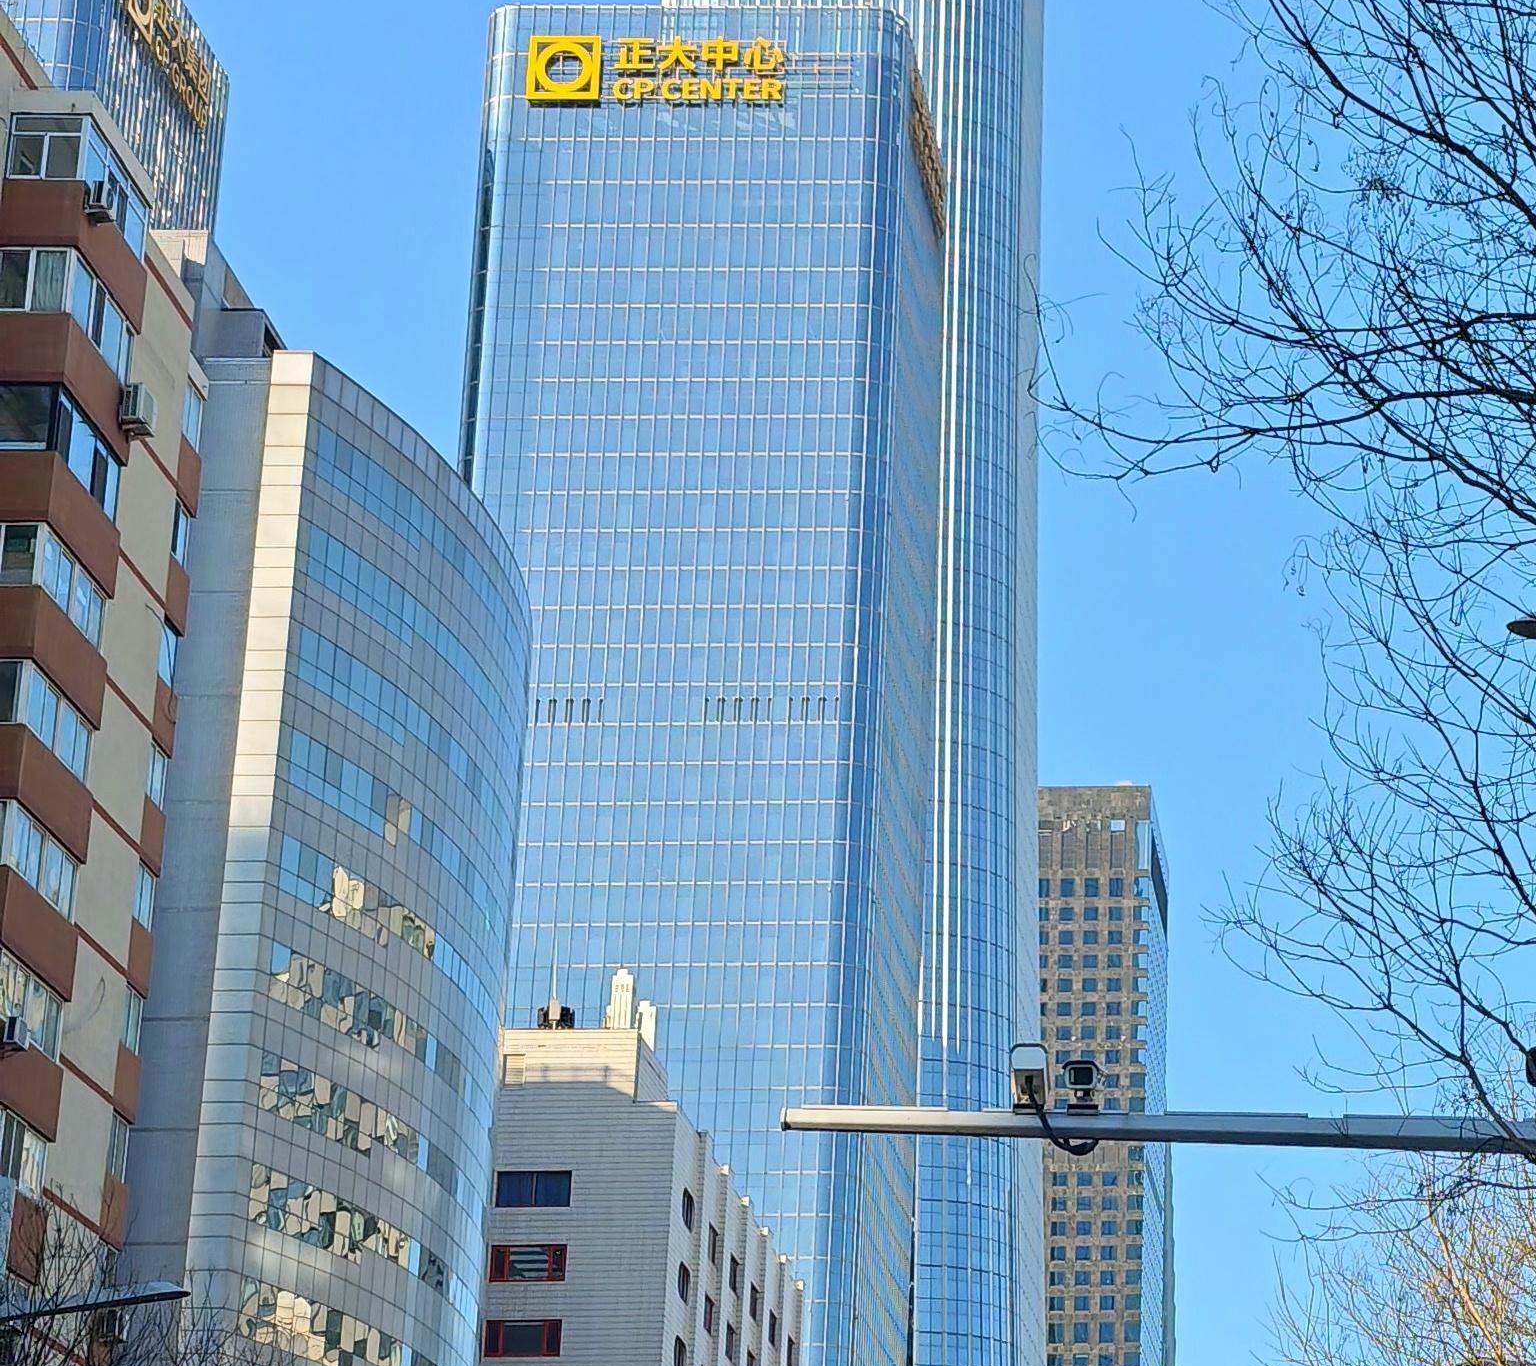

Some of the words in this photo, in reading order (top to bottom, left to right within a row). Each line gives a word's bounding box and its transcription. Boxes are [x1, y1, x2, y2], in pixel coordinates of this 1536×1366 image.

[614, 36, 785, 72] 正大中心
[171, 62, 208, 129] GROUP
[612, 78, 655, 100] CP
[661, 78, 783, 101] CENTER
